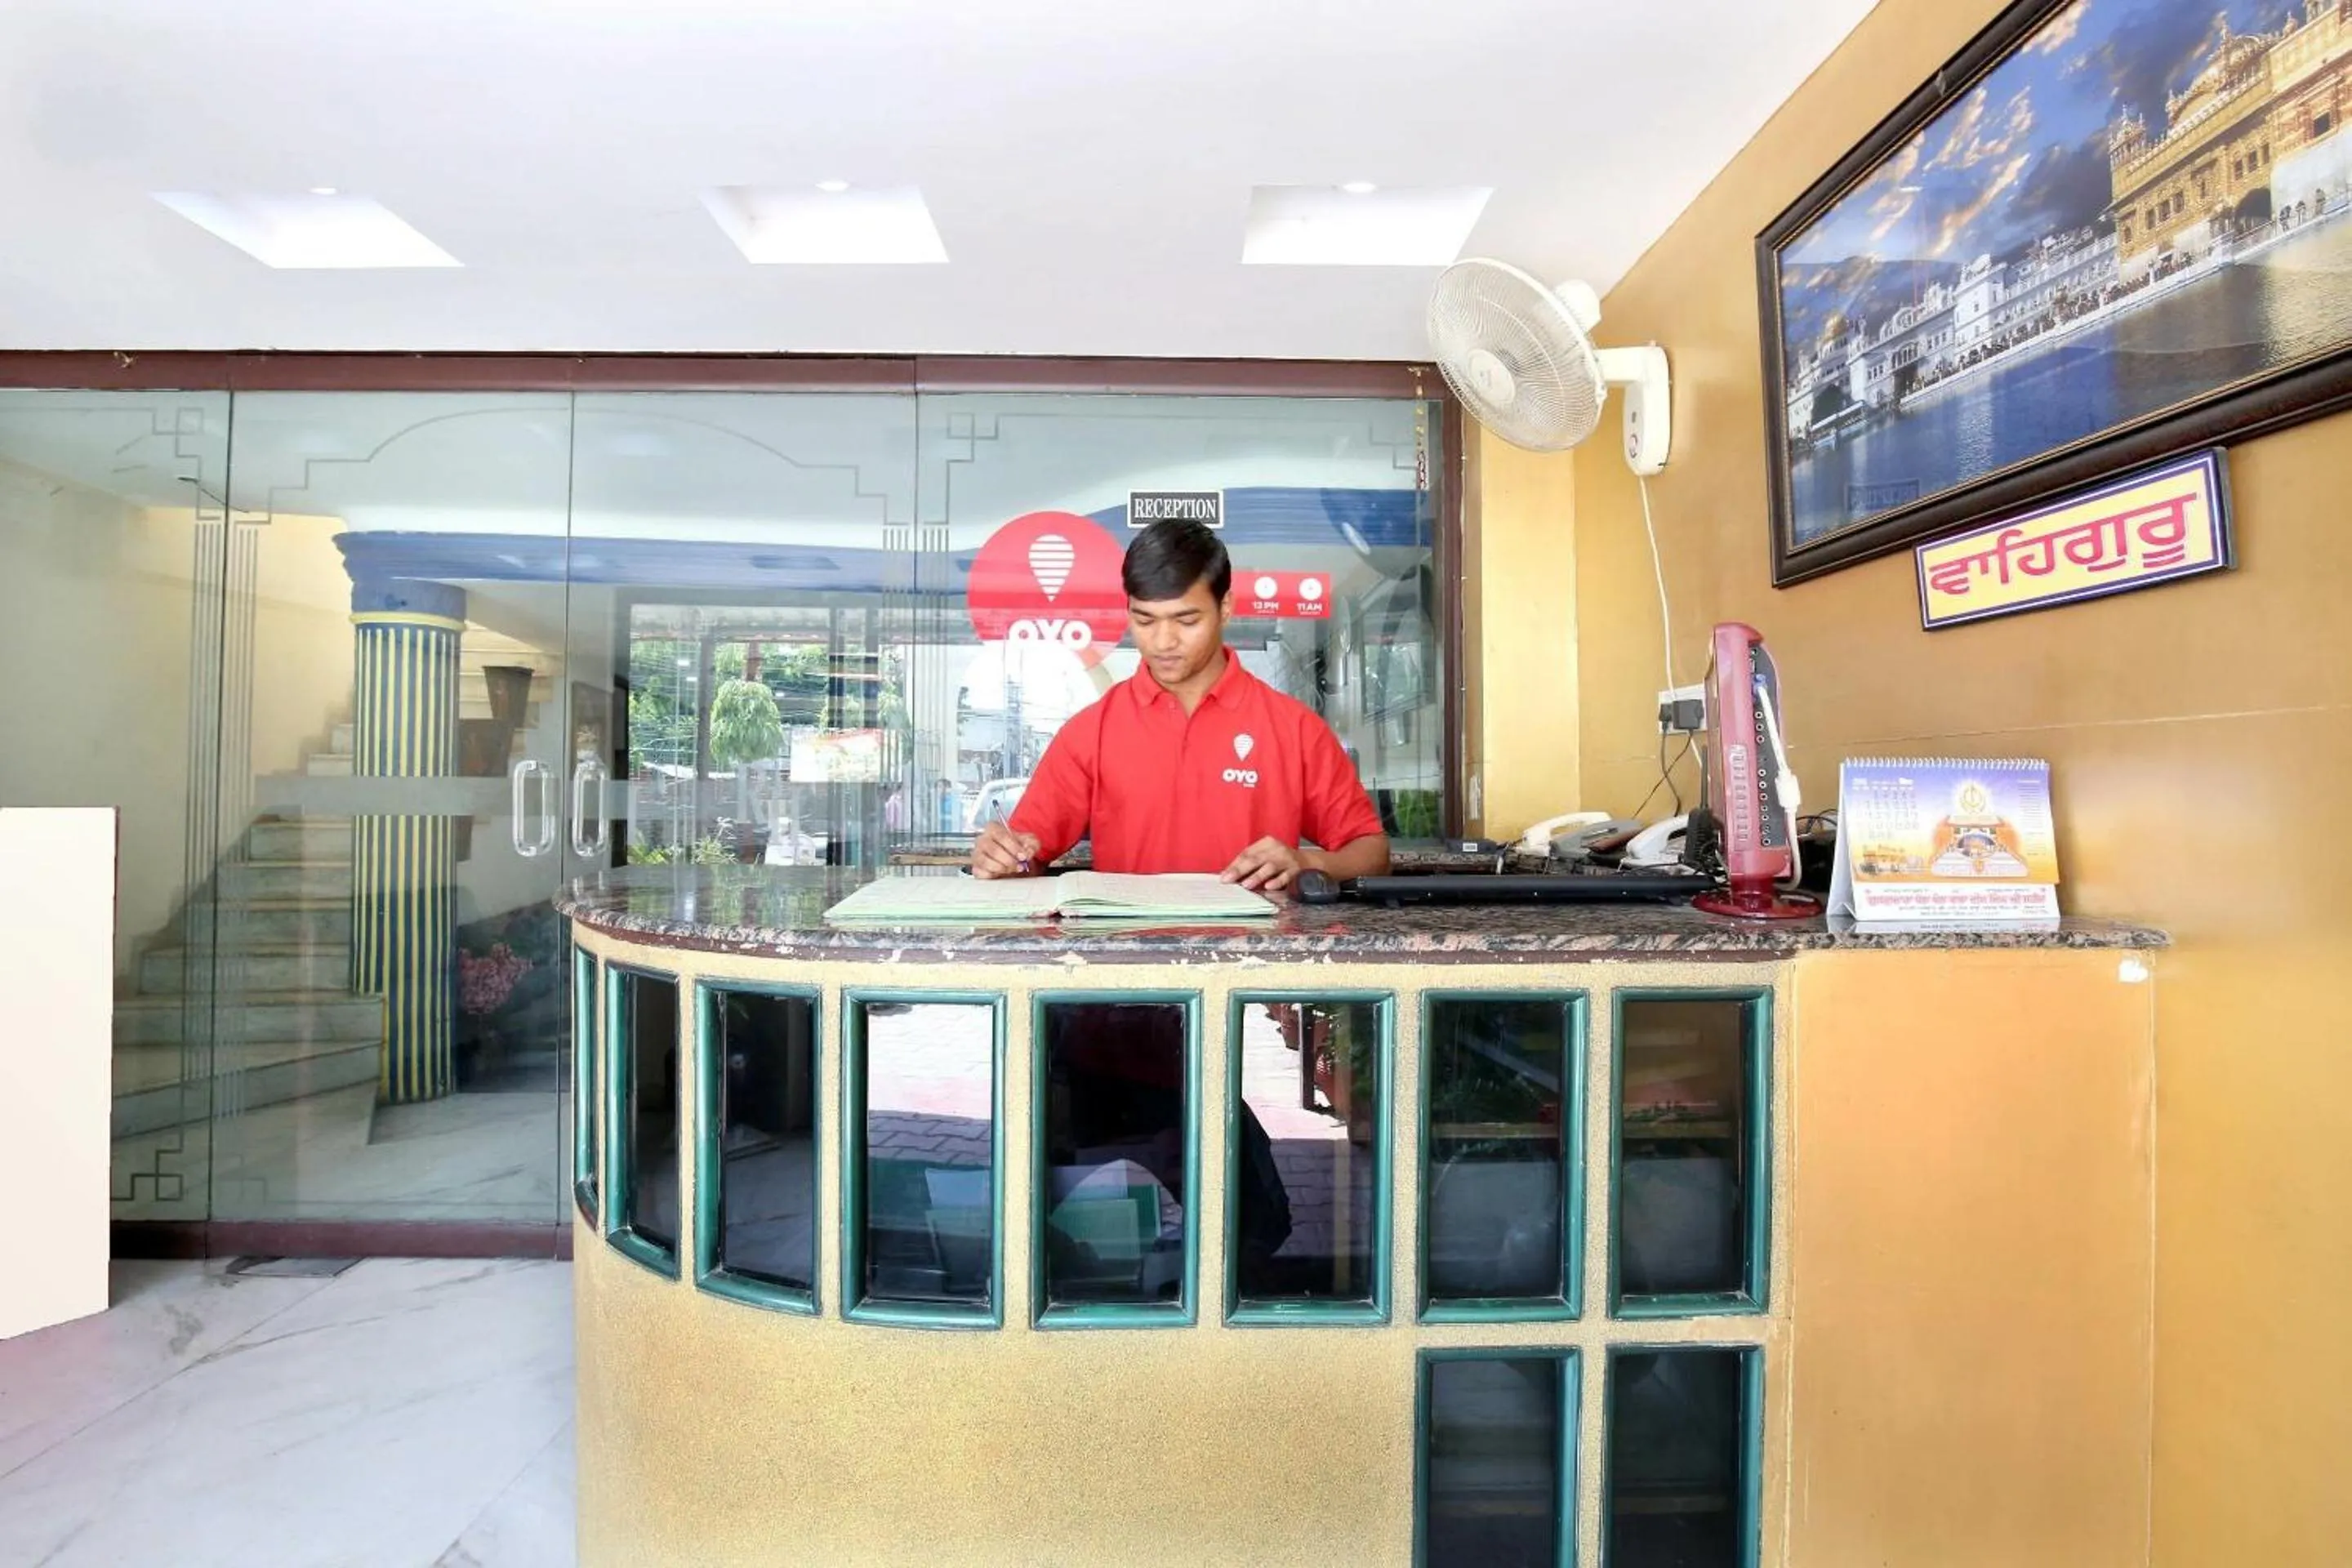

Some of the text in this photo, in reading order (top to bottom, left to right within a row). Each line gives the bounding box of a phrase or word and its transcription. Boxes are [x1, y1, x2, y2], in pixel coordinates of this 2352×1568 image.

[1134, 497, 1217, 519] RECEPTION
[1929, 492, 2198, 595] ਵਾਹਿਗੁਰੂ
[1264, 601, 1279, 611] PM
[1307, 604, 1322, 612] AM
[1009, 618, 1092, 651] OYO
[1223, 768, 1258, 784] OYO
